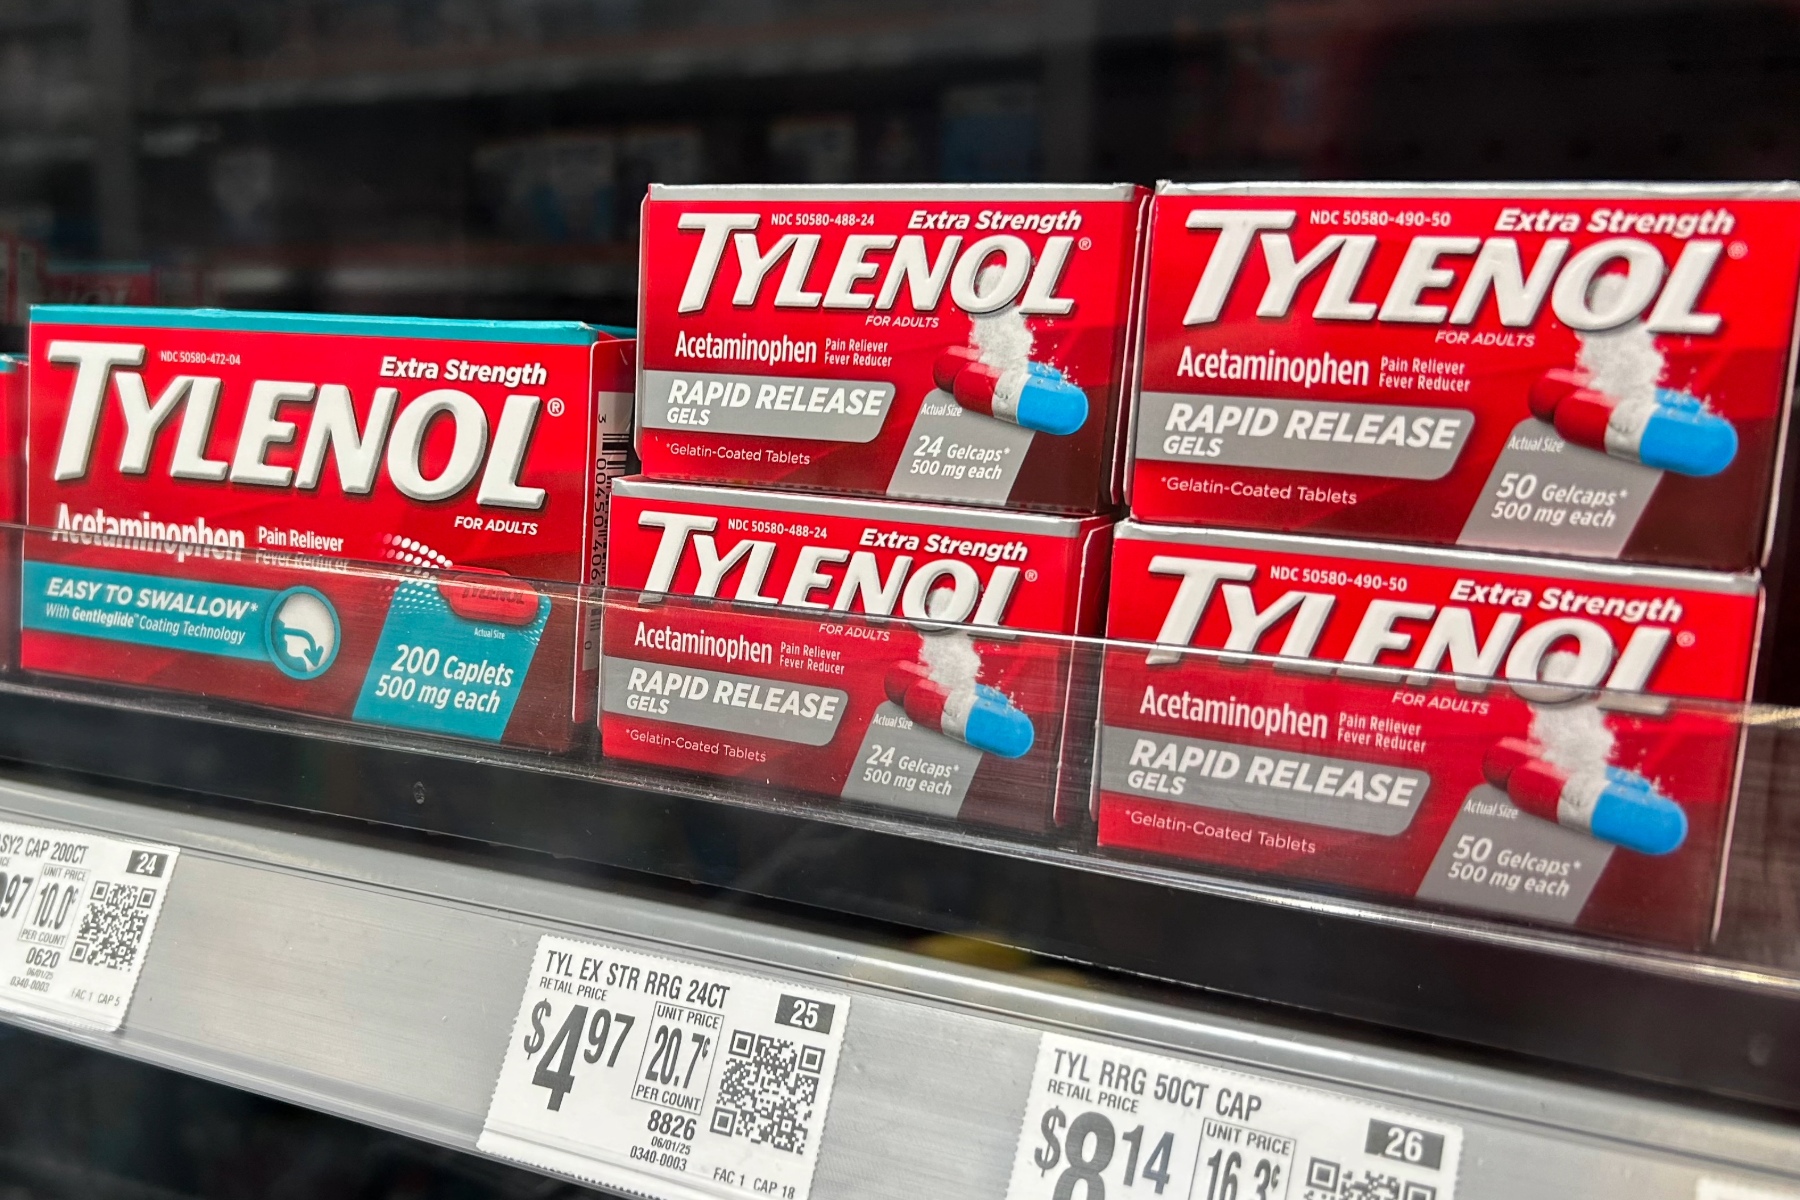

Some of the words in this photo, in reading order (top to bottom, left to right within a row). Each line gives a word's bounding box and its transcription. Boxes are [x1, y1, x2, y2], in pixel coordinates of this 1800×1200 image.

[771, 213, 793, 225] NDC
[795, 213, 875, 226] 50580-488-24
[908, 211, 970, 229] Extra
[974, 211, 1082, 234] Strength
[1310, 211, 1339, 225] NDC
[1342, 211, 1450, 227] 50580-490-50
[1495, 209, 1579, 232] Extra
[1586, 209, 1735, 235] Strength
[866, 316, 892, 326] FOR
[895, 316, 939, 328] ADULTS
[160, 350, 177, 363] NDC
[180, 352, 240, 366] 50580-472-04
[675, 331, 816, 366] Acetaminophen
[825, 339, 845, 350] Pain
[849, 340, 888, 352] Reliever
[380, 356, 440, 380] Extra
[444, 359, 546, 388] Strength
[824, 354, 849, 364] Fever
[852, 354, 892, 367] Reducer
[1177, 347, 1368, 388] Acetaminophen
[1380, 357, 1407, 371] Pain
[1412, 357, 1465, 375] Reliever
[1378, 374, 1413, 388] Fever
[1418, 375, 1471, 393] Reducer
[668, 380, 750, 408] RAPID
[755, 383, 886, 416] RELEASE
[667, 408, 710, 426] GELS
[1164, 403, 1278, 437] RAPID
[1284, 409, 1460, 449] RELEASE
[766, 451, 810, 465] Tablets
[914, 436, 941, 456] 24
[1163, 436, 1223, 459] GELS
[910, 461, 938, 475] 500
[941, 465, 964, 480] mg
[968, 464, 1002, 480] each
[1297, 486, 1357, 505] Tablets
[1496, 473, 1536, 500] 50
[454, 515, 481, 530] FOR
[485, 518, 538, 536] ADULTS
[728, 519, 749, 531] NDC
[752, 521, 827, 538] 50580-488-24
[1491, 502, 1530, 522] 500
[1533, 506, 1565, 527] mg
[1570, 508, 1616, 529] each
[52, 504, 244, 562] Acetaminophen
[258, 526, 288, 546] Pain
[290, 530, 343, 553] Reliever
[860, 528, 918, 550] Extra
[923, 534, 1028, 563] Strength
[47, 578, 100, 598] EASY
[106, 584, 132, 602] TO
[1270, 565, 1299, 581] NDC
[1302, 567, 1407, 592] 50580-490-50
[1450, 580, 1532, 607] Extra
[1539, 586, 1683, 624] Strength
[46, 604, 70, 618] With
[140, 616, 178, 636] Coating
[182, 620, 244, 644] Technology
[819, 623, 843, 635] FOR
[845, 625, 890, 641] ADULTS
[635, 622, 772, 664] Acetaminophen
[780, 642, 800, 656] Pain
[803, 645, 841, 660] Reliever
[391, 645, 437, 675] 200
[444, 655, 514, 688] Caplets
[779, 655, 804, 670] Fever
[807, 659, 845, 675] Reducer
[376, 674, 414, 699] 500
[418, 683, 450, 708] mg
[454, 685, 500, 714] each
[626, 695, 669, 715] GELS
[627, 668, 709, 702] RAPID
[713, 679, 839, 721] RELEASE
[1391, 691, 1428, 707] FOR
[1430, 694, 1489, 714] ADULTS
[1140, 685, 1327, 739] Acetaminophen
[1339, 711, 1366, 731] Pain
[1370, 716, 1422, 737] Reliever
[723, 744, 766, 762] Tablets
[1337, 728, 1372, 746] Fever
[1375, 734, 1427, 754] Reducer
[866, 745, 893, 767] 24
[863, 768, 889, 785] 500
[893, 774, 916, 792] mg
[919, 778, 951, 795] each
[1127, 770, 1185, 795] GELS
[1129, 739, 1241, 779] RAPID
[1246, 756, 1419, 806] RELEASE
[0, 834, 23, 855] SY2
[1257, 829, 1316, 853] Tablets
[1453, 835, 1492, 864] 50
[1448, 861, 1485, 883] 500
[1489, 871, 1520, 892] mg
[1524, 875, 1569, 898] each
[0, 872, 33, 919] 97
[539, 976, 574, 994] RETAIL
[577, 984, 608, 1002] PRICE
[547, 950, 573, 977] TYL
[579, 958, 600, 982] EX
[607, 963, 640, 990] STR
[644, 970, 681, 999] RRG
[686, 979, 730, 1009] 24CT
[657, 1005, 682, 1022] UNIT
[686, 1011, 720, 1029] PRICE
[790, 1001, 818, 1028] 25
[636, 1084, 658, 1103] PER
[661, 1090, 701, 1112] COUNT
[1048, 1080, 1095, 1104] RETAIL
[1098, 1091, 1139, 1114] PRICE
[1053, 1049, 1090, 1081] TYL
[1099, 1061, 1147, 1095] RRG
[1153, 1074, 1209, 1110] 50CT
[1216, 1088, 1262, 1121] CAP
[647, 1110, 696, 1141] 8826
[651, 1136, 691, 1155] 06/01/25
[1206, 1123, 1242, 1145] UNIT
[1247, 1133, 1290, 1155] PRICE
[1385, 1127, 1424, 1162] 26
[629, 1146, 687, 1171] 0340-0003
[713, 1168, 736, 1184] FAC
[739, 1174, 745, 1187] 1
[753, 1178, 778, 1194] CAP
[782, 1184, 795, 1199] 18
